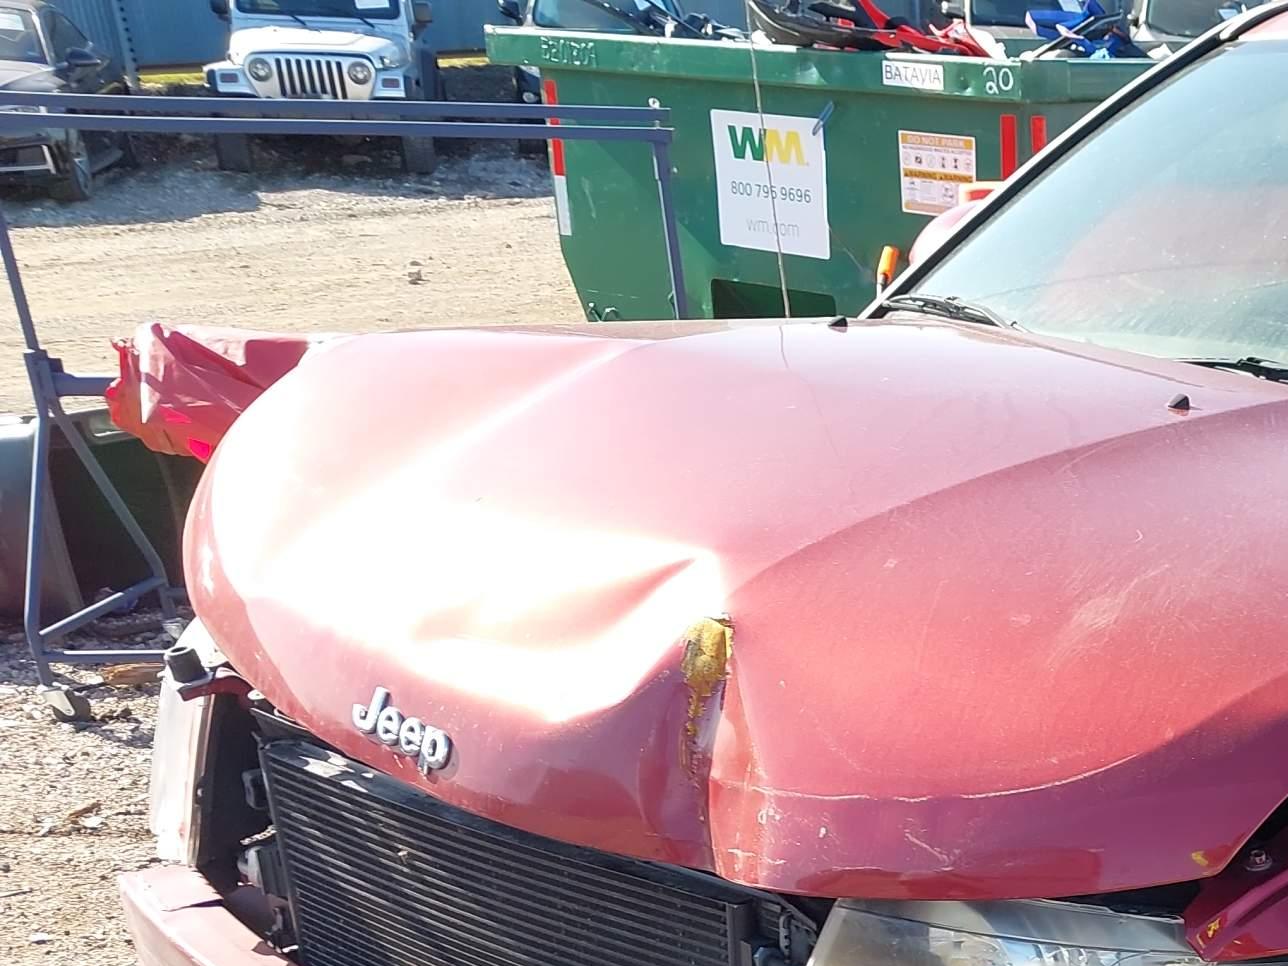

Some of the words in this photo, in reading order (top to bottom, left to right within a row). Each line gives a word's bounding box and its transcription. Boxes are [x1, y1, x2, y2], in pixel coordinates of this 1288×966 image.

[885, 64, 941, 85] BATAVIA
[983, 66, 1014, 94] 20
[731, 180, 753, 196] 800
[780, 186, 812, 203] 9696
[746, 218, 800, 238] wm.com
[352, 686, 453, 776] Jeep
